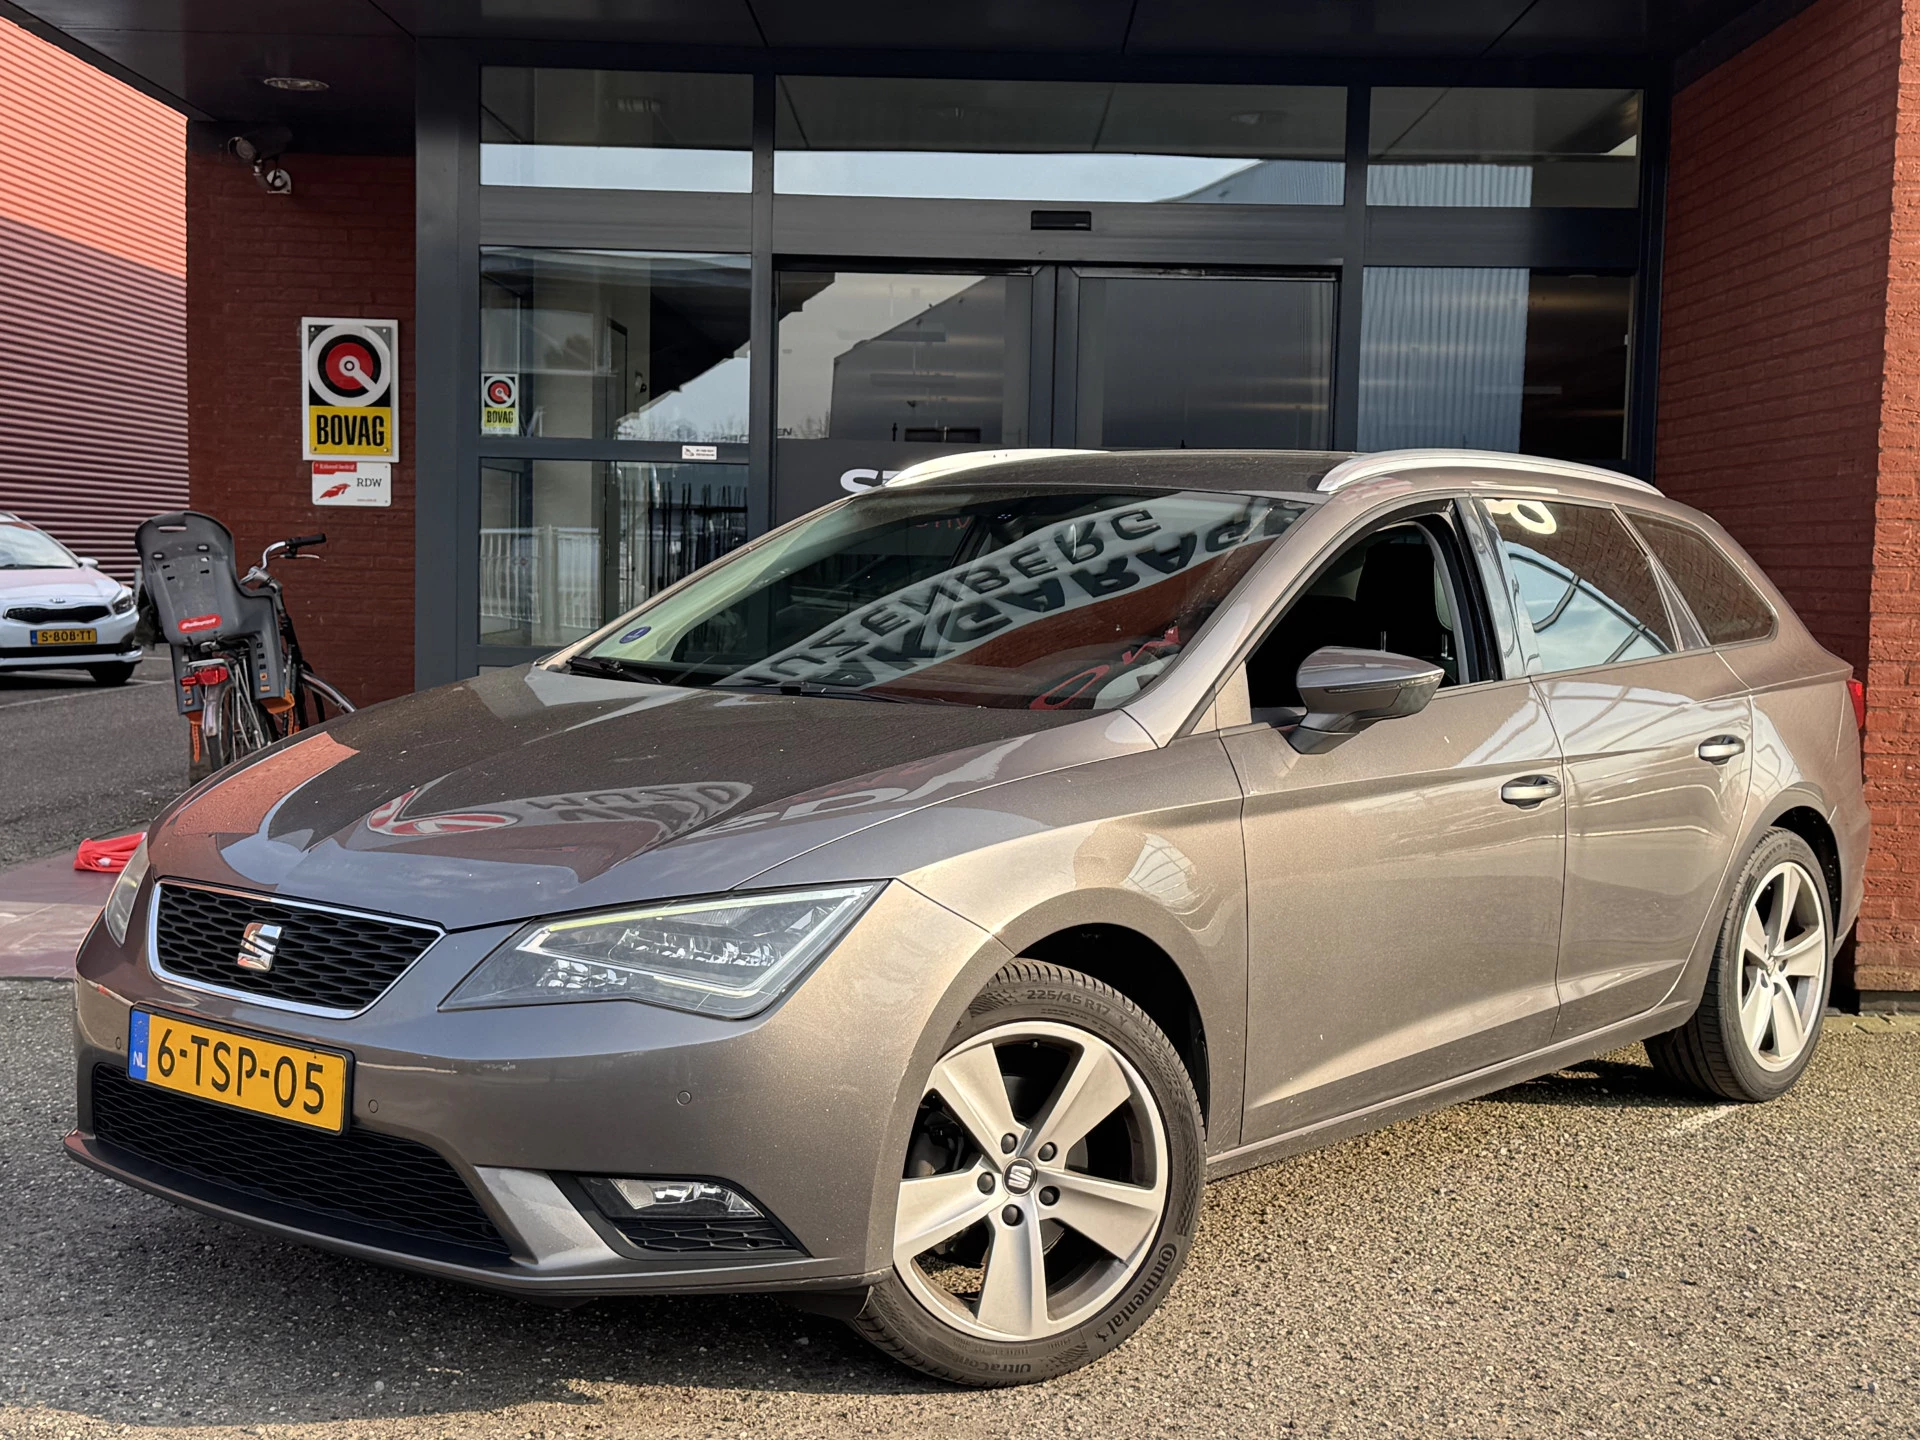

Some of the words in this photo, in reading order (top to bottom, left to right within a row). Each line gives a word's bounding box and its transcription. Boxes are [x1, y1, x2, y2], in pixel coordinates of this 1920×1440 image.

[486, 410, 514, 424] BOVAG
[316, 414, 385, 447] BOVAG
[356, 478, 382, 488] RDW
[1027, 990, 1082, 1005] 225/45
[1084, 998, 1111, 1016] R17
[132, 1051, 146, 1068] NL
[157, 1028, 325, 1115] 6-TSP-05
[1106, 1243, 1177, 1335] Continental
